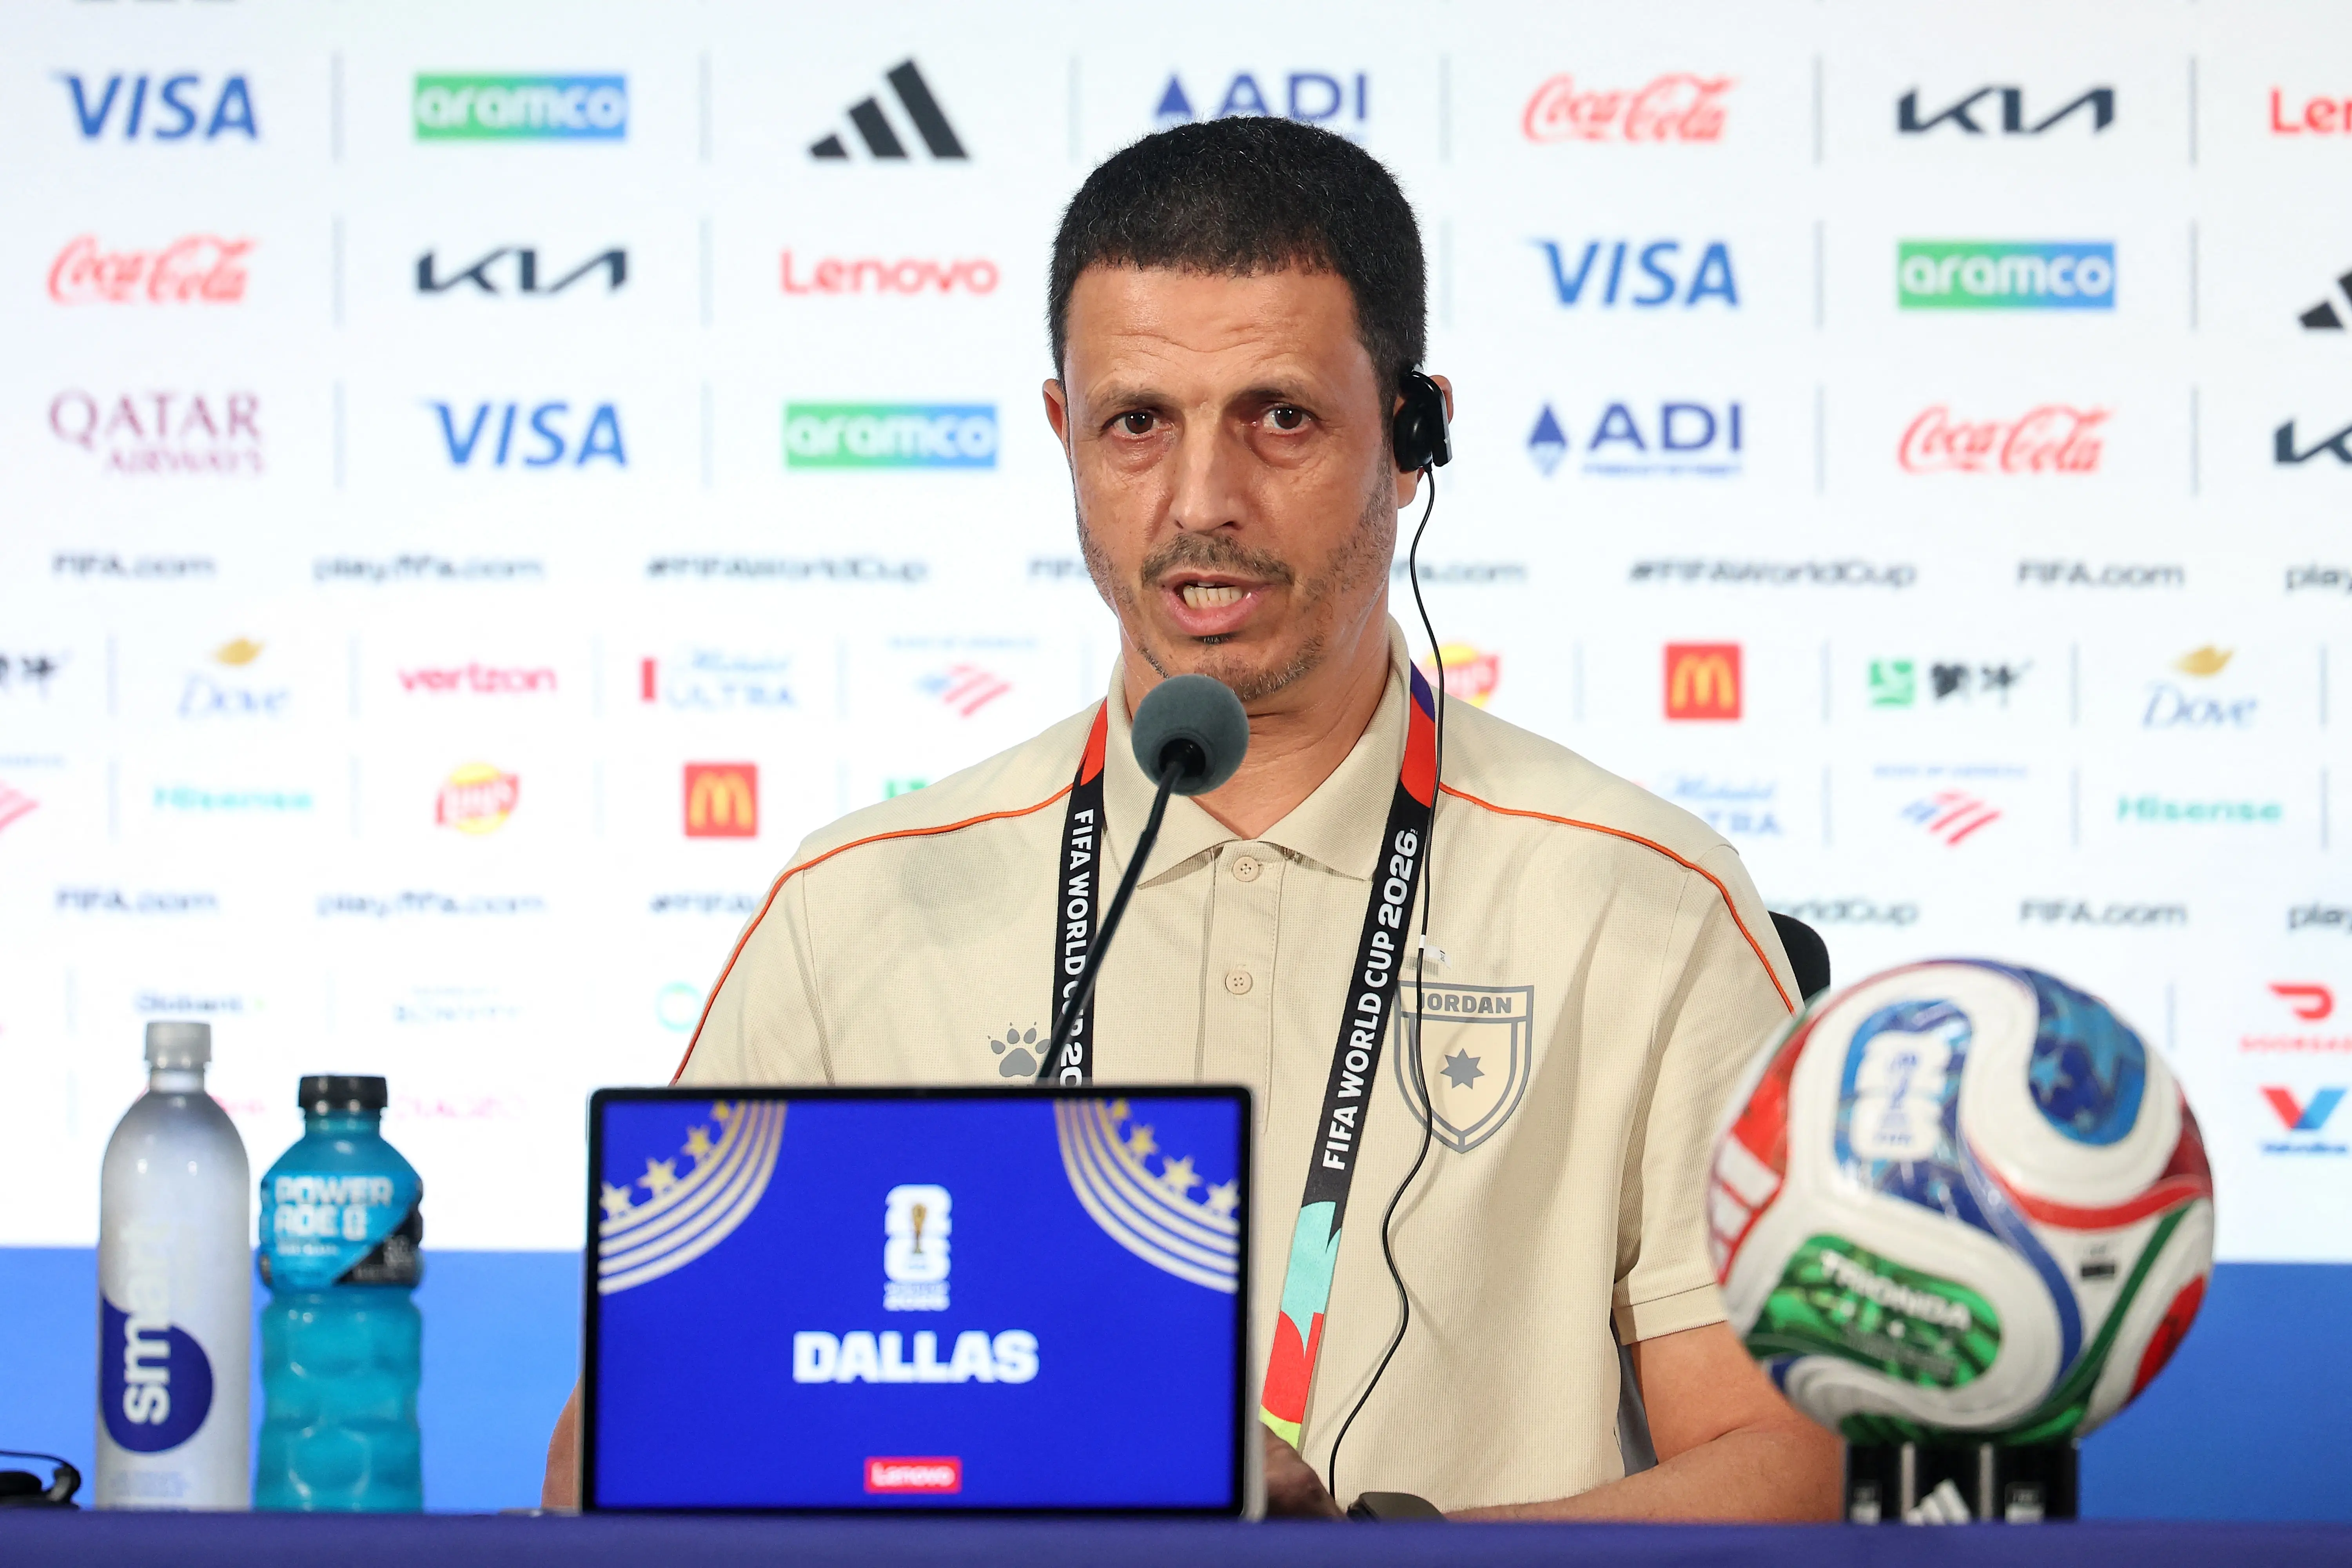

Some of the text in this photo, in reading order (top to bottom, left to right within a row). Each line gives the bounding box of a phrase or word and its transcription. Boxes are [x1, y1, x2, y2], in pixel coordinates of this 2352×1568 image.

[57, 73, 258, 141] VISA
[419, 86, 625, 129] aramco
[1213, 71, 1367, 119] ADI
[1896, 86, 2115, 134] KIA
[416, 247, 628, 294] KIA
[780, 249, 1000, 296] Lenovo
[1533, 239, 1739, 308] VISA
[1902, 254, 2112, 297] aramco
[47, 390, 260, 451] QATAR
[425, 400, 628, 468] VISA
[787, 414, 996, 459] aramco
[1588, 402, 1742, 453] ADI
[1628, 558, 1917, 590] #FIFAWorldCup
[2017, 560, 2185, 587] FIFA.com
[2142, 680, 2259, 728] Dove
[2117, 796, 2283, 824] Hisense
[1069, 808, 1094, 870] FIFA
[1377, 829, 1418, 929] 2026
[1064, 871, 1090, 976] WORLD
[2019, 899, 2189, 927] FIFA.com
[1364, 931, 1396, 988] CUP
[1416, 993, 1512, 1013] JORDAN
[1337, 992, 1382, 1098] WORLD
[1322, 1105, 1358, 1171] FIFA
[275, 1175, 392, 1207] POWER
[793, 1328, 1040, 1384] DALLAS
